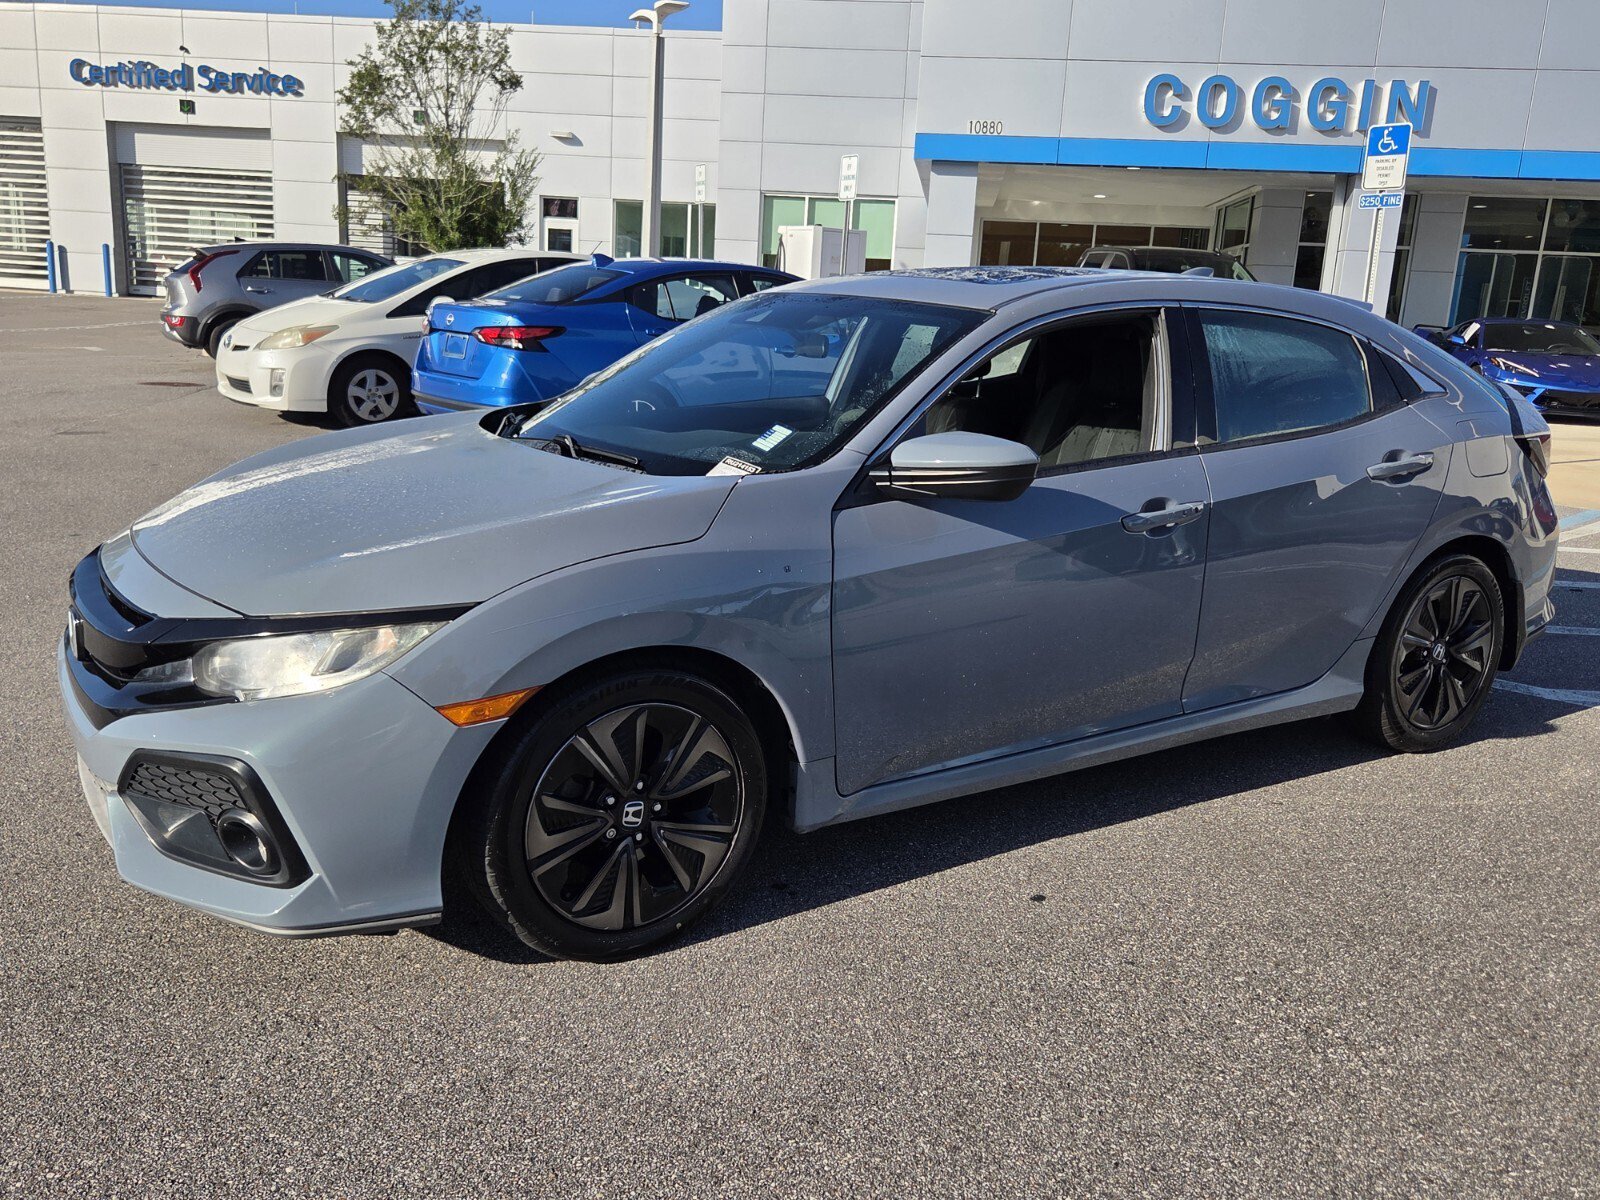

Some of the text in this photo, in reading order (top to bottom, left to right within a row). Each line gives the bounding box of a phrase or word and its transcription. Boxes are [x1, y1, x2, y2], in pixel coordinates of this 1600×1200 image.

[70, 58, 301, 95] Certified Service
[1144, 73, 1431, 132] COGGIN
[969, 120, 1003, 135] 10880
[1360, 195, 1401, 207] $250 FINE
